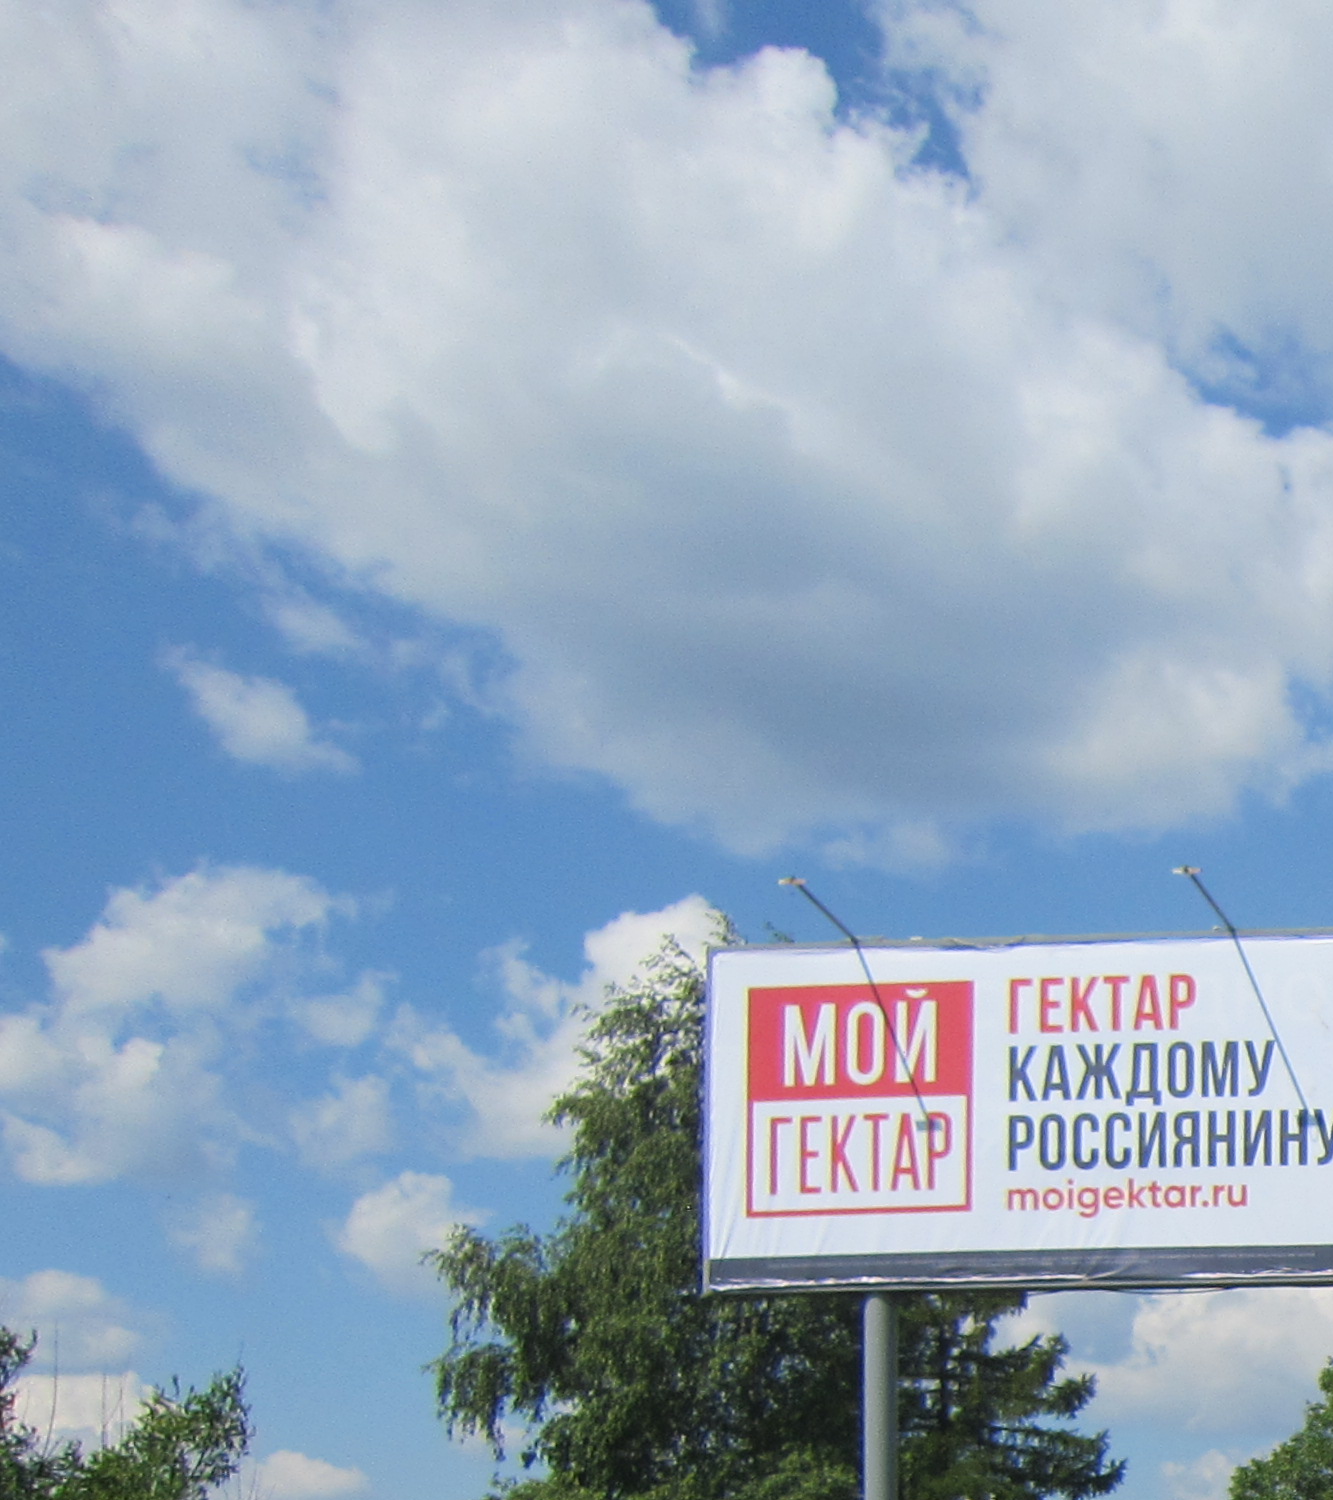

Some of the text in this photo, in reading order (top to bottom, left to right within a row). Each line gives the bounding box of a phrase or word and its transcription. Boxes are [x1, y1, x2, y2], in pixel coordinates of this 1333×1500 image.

[1007, 974, 1196, 1034] ГЕКТАР
[782, 988, 938, 1088] МОЙ
[1008, 1040, 1276, 1106] КАЖДОМУ
[768, 1112, 952, 1196] ГЕКТАР
[1007, 1179, 1249, 1217] moigektar.ru
